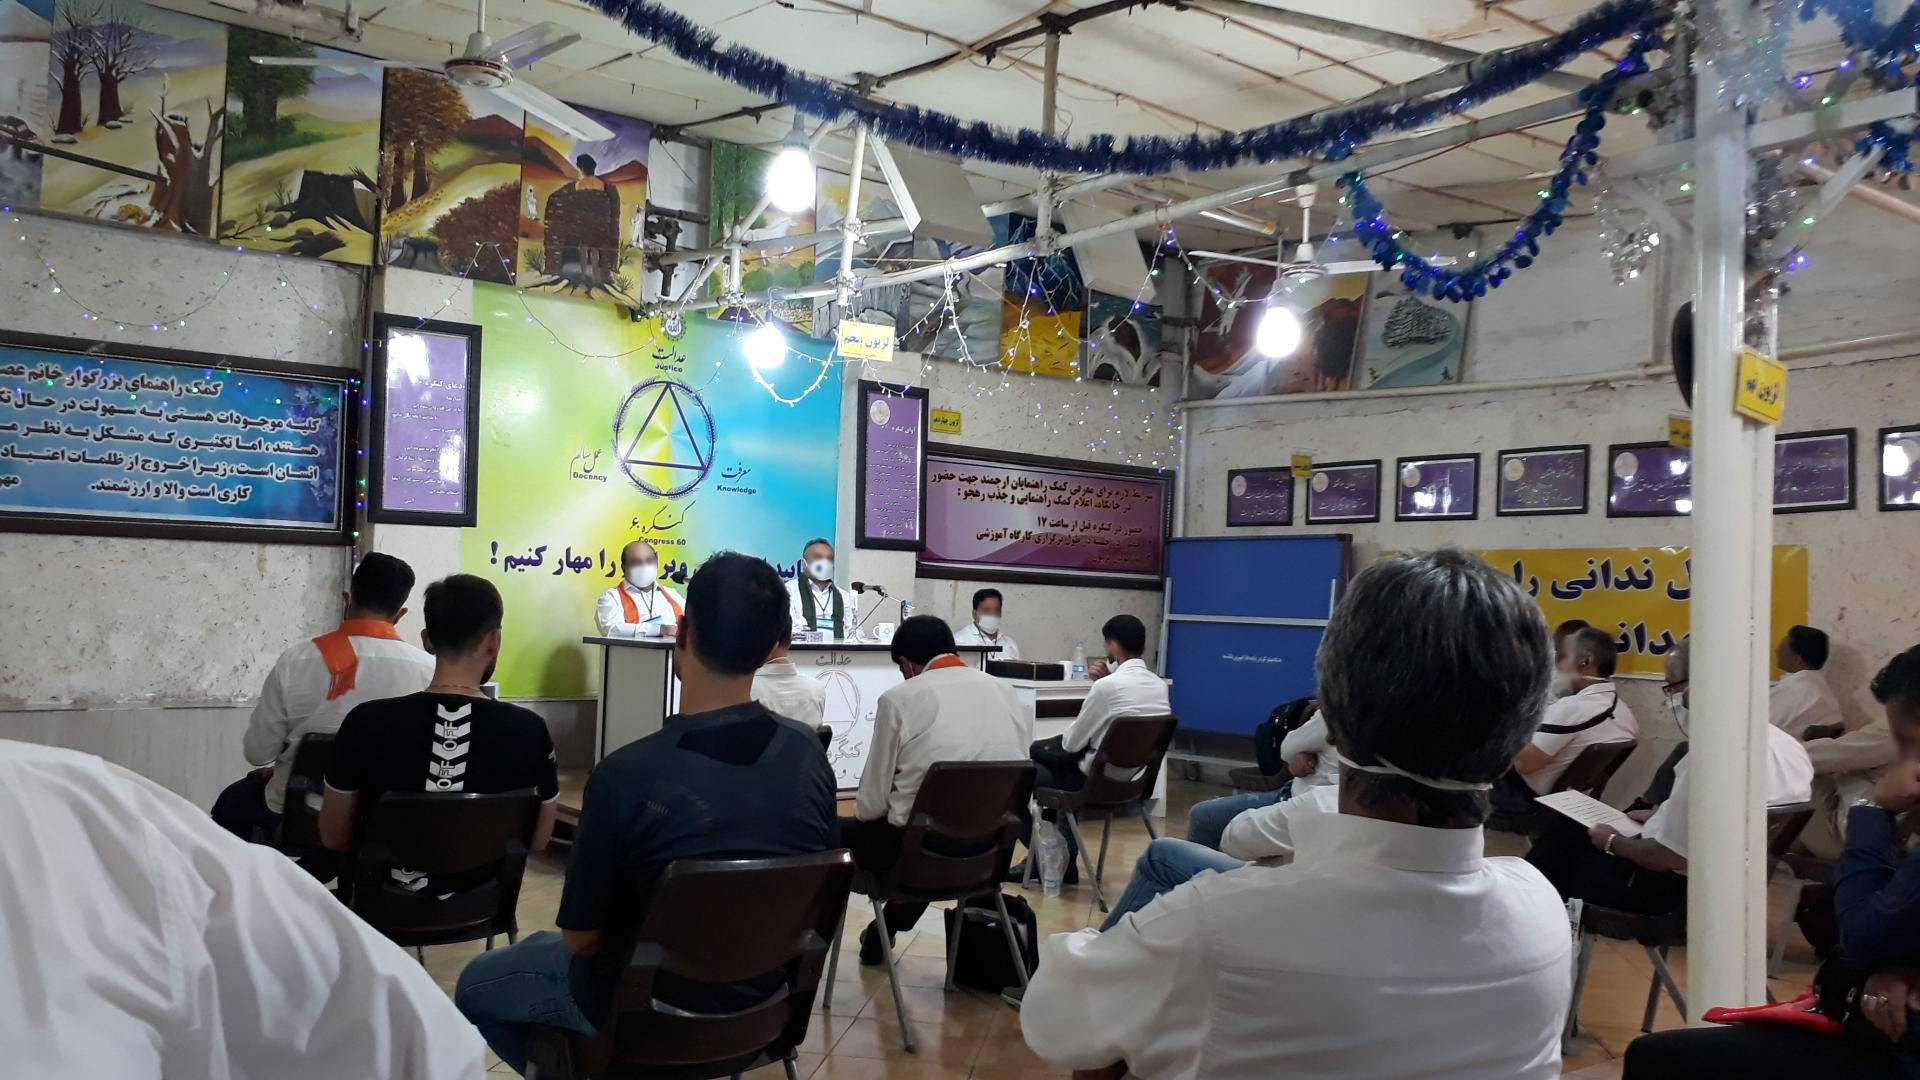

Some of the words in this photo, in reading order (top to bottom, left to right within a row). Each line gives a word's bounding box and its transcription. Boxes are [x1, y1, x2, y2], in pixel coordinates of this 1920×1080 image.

[651, 346, 686, 363] عدالت
[28, 364, 62, 381] خانم
[654, 364, 683, 372] Justice
[125, 374, 183, 397] راهنمای
[186, 381, 221, 397] کمک
[14, 392, 55, 408] حال
[59, 400, 76, 413] در
[79, 399, 136, 417] سهولت
[140, 406, 163, 420] به
[165, 408, 214, 423] هستی
[22, 421, 61, 436] نظر
[217, 412, 283, 431] موجودات
[286, 418, 319, 433] کلیه
[64, 428, 89, 440] به
[93, 426, 144, 441] مشکل
[148, 432, 175, 444] که
[178, 435, 232, 450] تکثیری
[236, 437, 262, 451] اما
[0, 445, 65, 464] اعتیاد
[67, 450, 124, 466] ظلمات
[127, 455, 139, 470] از
[141, 456, 189, 472] خروج
[193, 458, 227, 476] زیرا
[276, 467, 318, 481] انسان
[573, 471, 608, 482] Decency
[721, 462, 752, 483] معرفت
[931, 469, 956, 483] حضور
[152, 485, 161, 497] و
[163, 481, 185, 500] والا
[187, 484, 215, 498] است
[217, 486, 250, 502] کاری
[716, 484, 757, 494] Knowledge
[1049, 481, 1069, 492] کمک
[641, 500, 696, 534] کنگره
[676, 536, 687, 546] 60
[504, 545, 547, 573] کنیم
[552, 546, 593, 576] مهار
[600, 548, 616, 578] را
[1550, 557, 1655, 600] ندانی
[815, 651, 852, 666] عدالت
